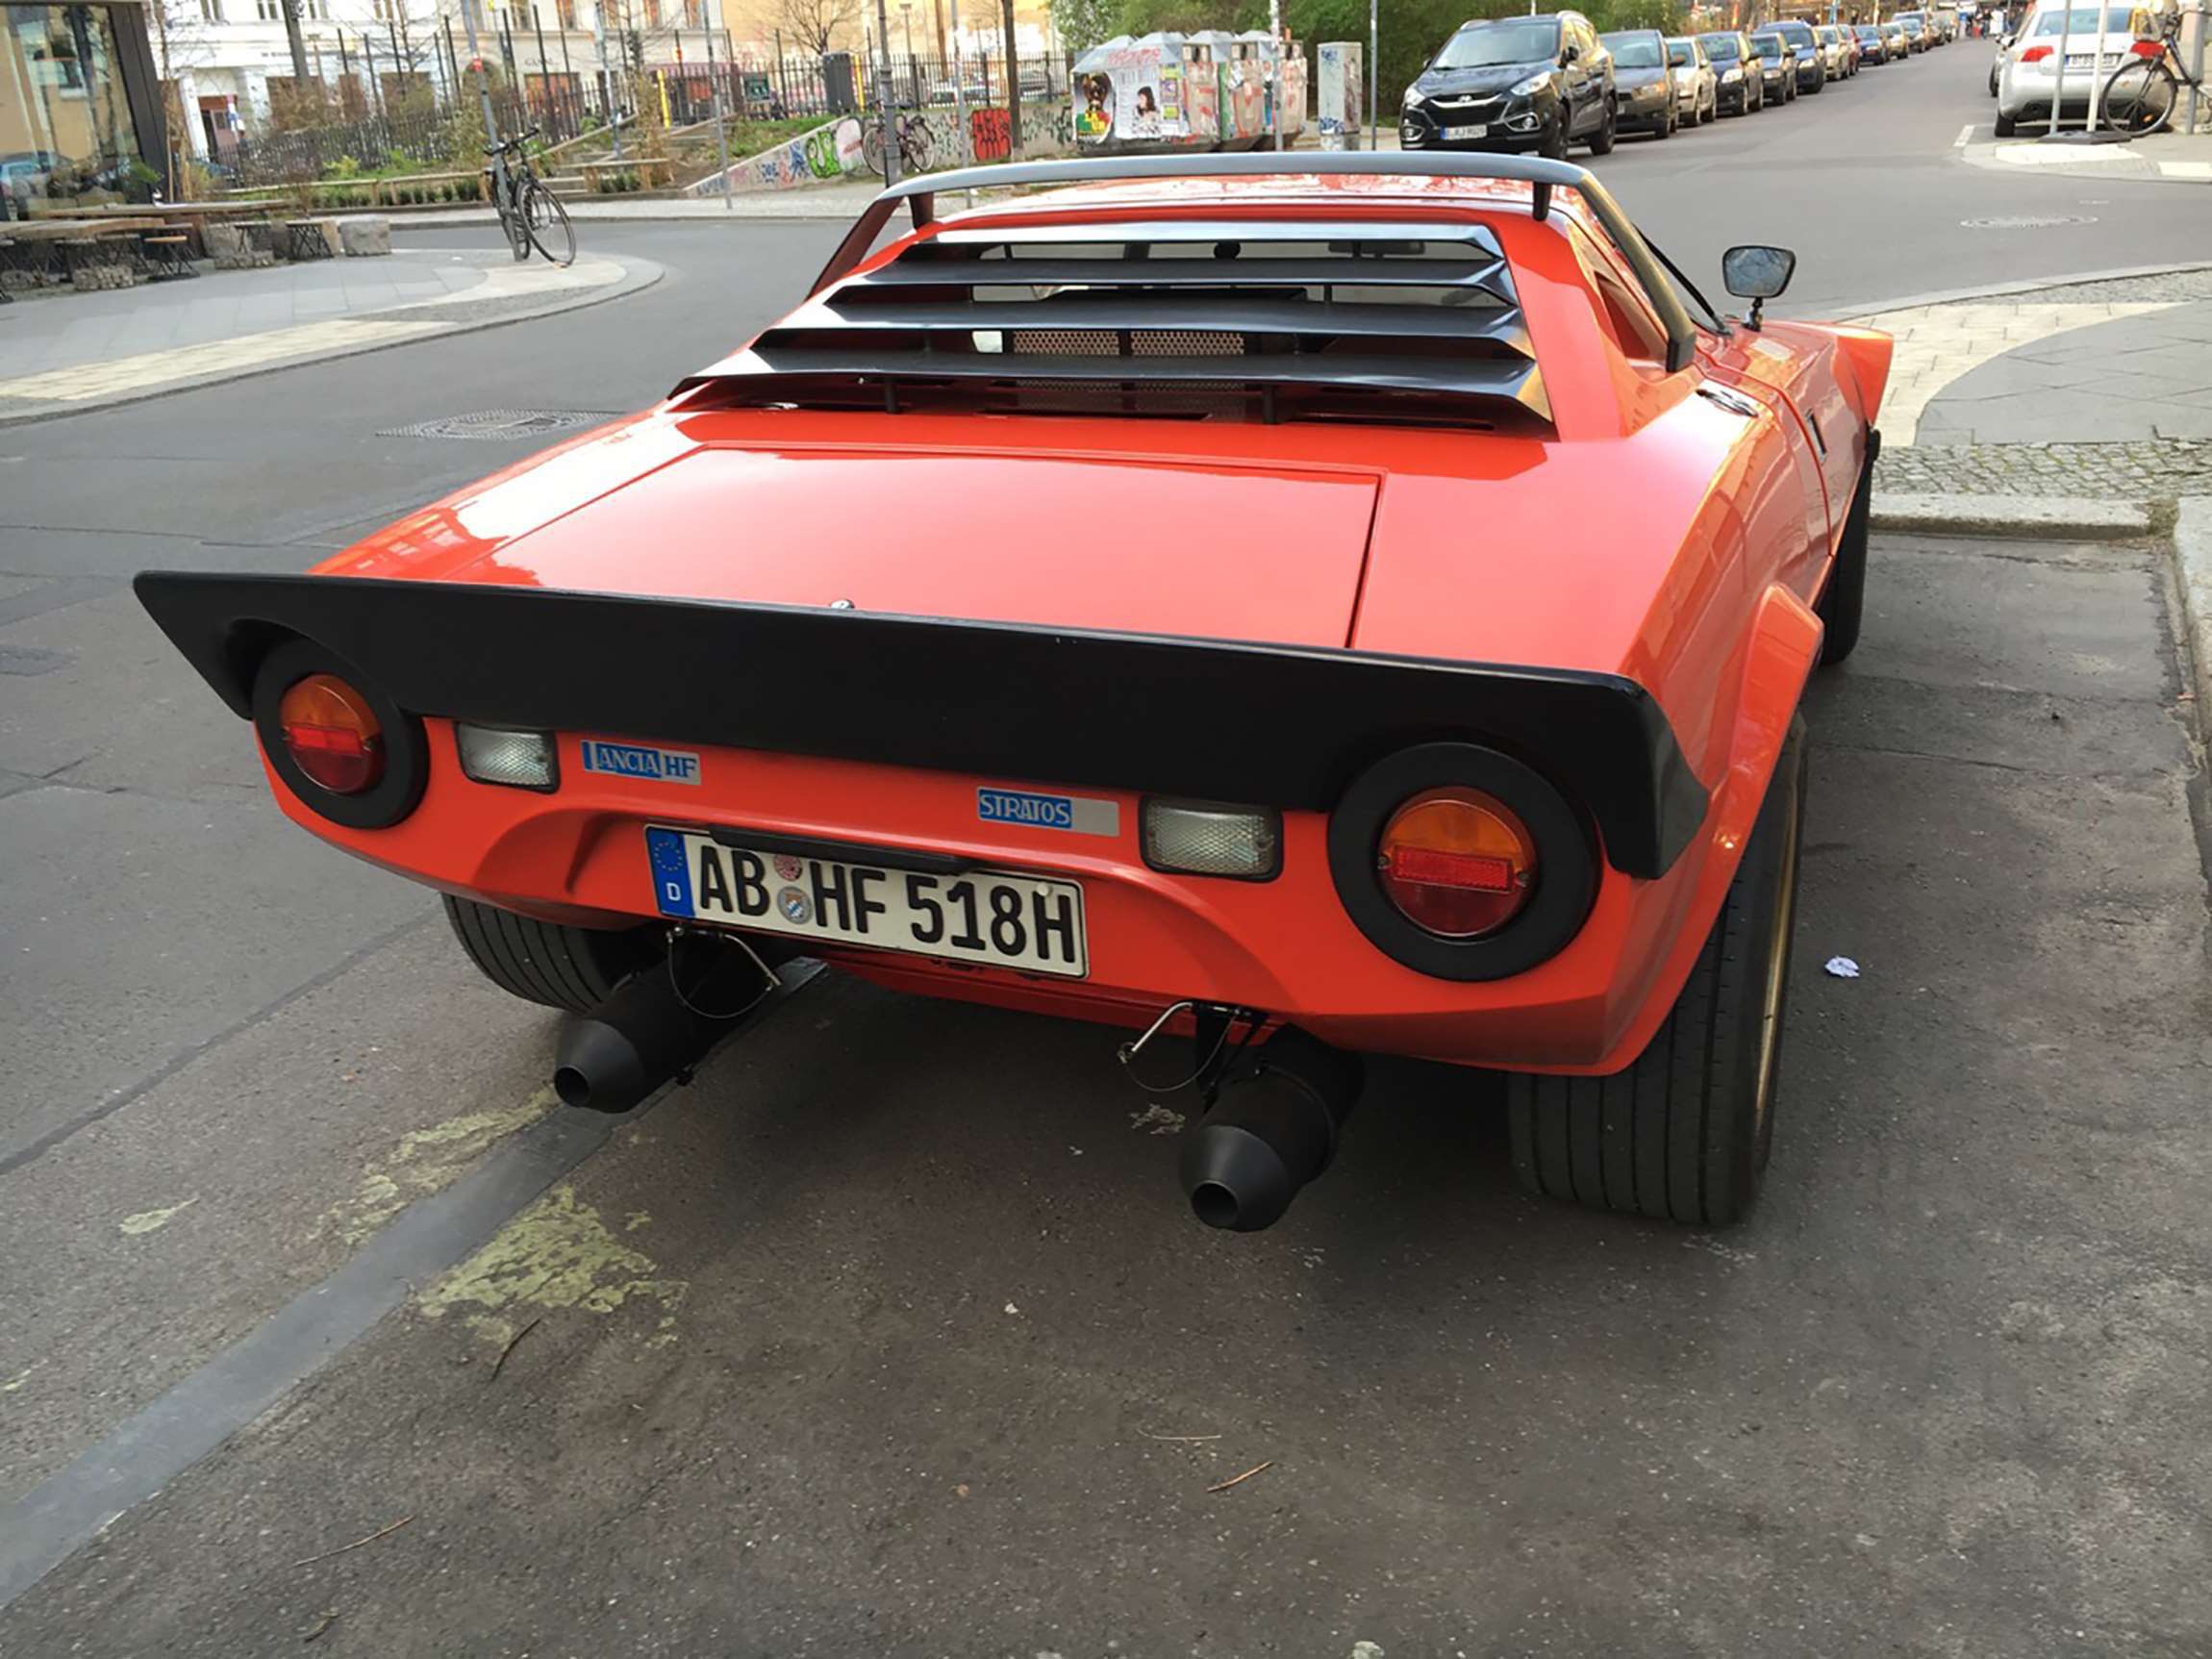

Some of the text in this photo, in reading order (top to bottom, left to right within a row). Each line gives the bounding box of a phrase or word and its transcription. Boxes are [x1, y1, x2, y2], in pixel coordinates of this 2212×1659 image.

[589, 742, 698, 778] LANCIA HF
[979, 793, 1071, 825] STRATOS
[666, 882, 681, 901] D
[700, 844, 1075, 964] AB HF 518H
